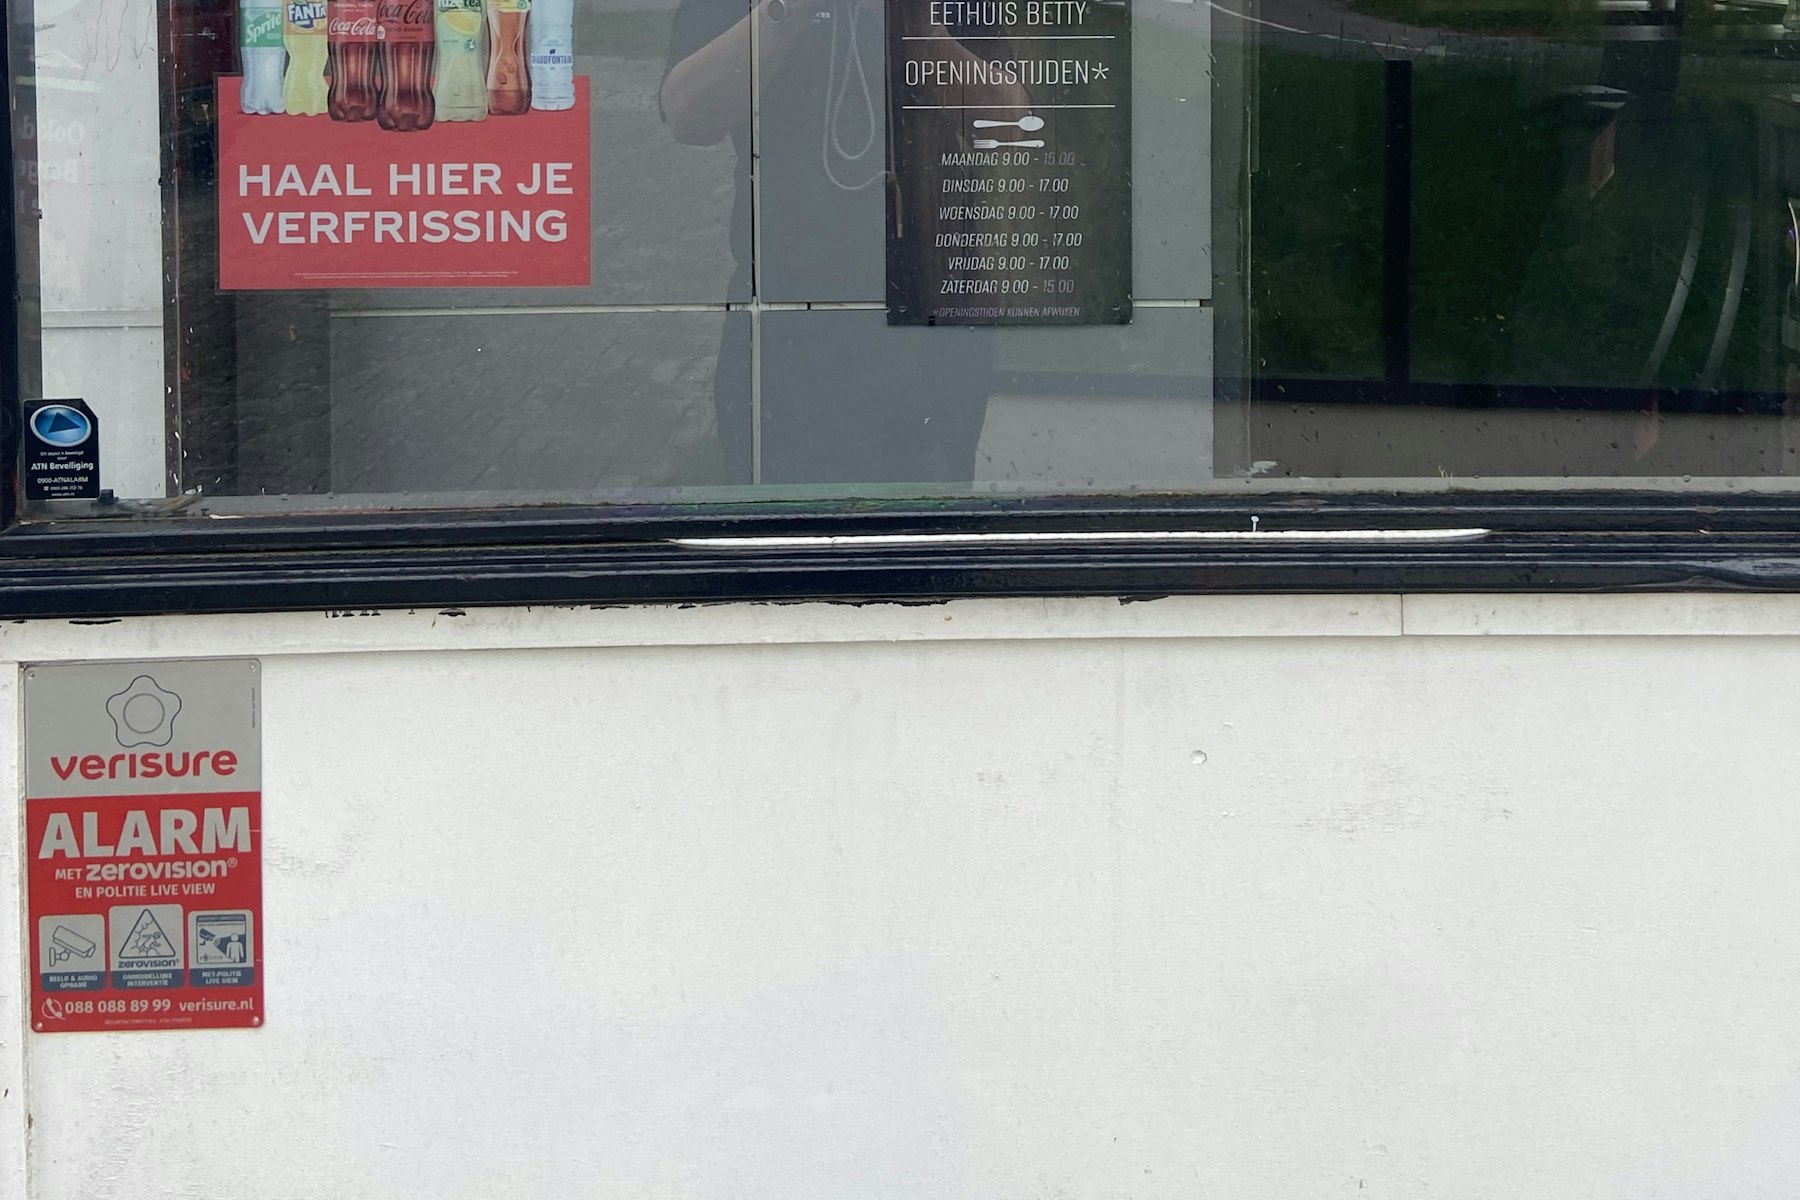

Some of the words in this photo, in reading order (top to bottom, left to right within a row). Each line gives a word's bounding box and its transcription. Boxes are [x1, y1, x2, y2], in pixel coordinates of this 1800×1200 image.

[287, 2, 327, 22] FANTA
[930, 1, 1018, 26] EETHUIS
[1026, 1, 1087, 25] BETTY
[245, 12, 282, 44] Sprite
[941, 152, 999, 166] MAANDAG
[1002, 152, 1030, 166] 9.00
[238, 163, 372, 197] HAAL
[388, 162, 503, 196] HIER
[516, 162, 574, 195] JE
[942, 178, 995, 193] DINSDAG
[997, 178, 1025, 193] 9.00
[1038, 178, 1069, 192] 17.00
[939, 206, 1005, 220] WOENSDAG
[1007, 205, 1036, 220] 9.00
[1048, 205, 1080, 220] 17.00
[241, 209, 568, 245] VERFRISSING
[935, 233, 1008, 248] DONDERDAG
[1011, 233, 1039, 247] 9.00
[1052, 232, 1083, 247] 17.00
[948, 256, 995, 271] VRIJDAG
[997, 256, 1026, 270] 9.00
[1039, 255, 1069, 270] 17.00
[940, 279, 998, 294] ZATERDAG
[1001, 279, 1029, 294] 9.00
[31, 462, 48, 471] ATN
[50, 750, 238, 782] verisure
[38, 806, 252, 860] ALARM
[55, 868, 83, 880] MET
[75, 886, 92, 898] EN
[96, 885, 147, 898] POLITIE
[150, 884, 179, 896] LIVE
[182, 883, 215, 895] VIEW
[65, 1001, 94, 1014] 088
[97, 1000, 126, 1013] 088
[130, 999, 149, 1012] 89
[152, 998, 171, 1012] 99
[178, 997, 254, 1012] verisure.nl
